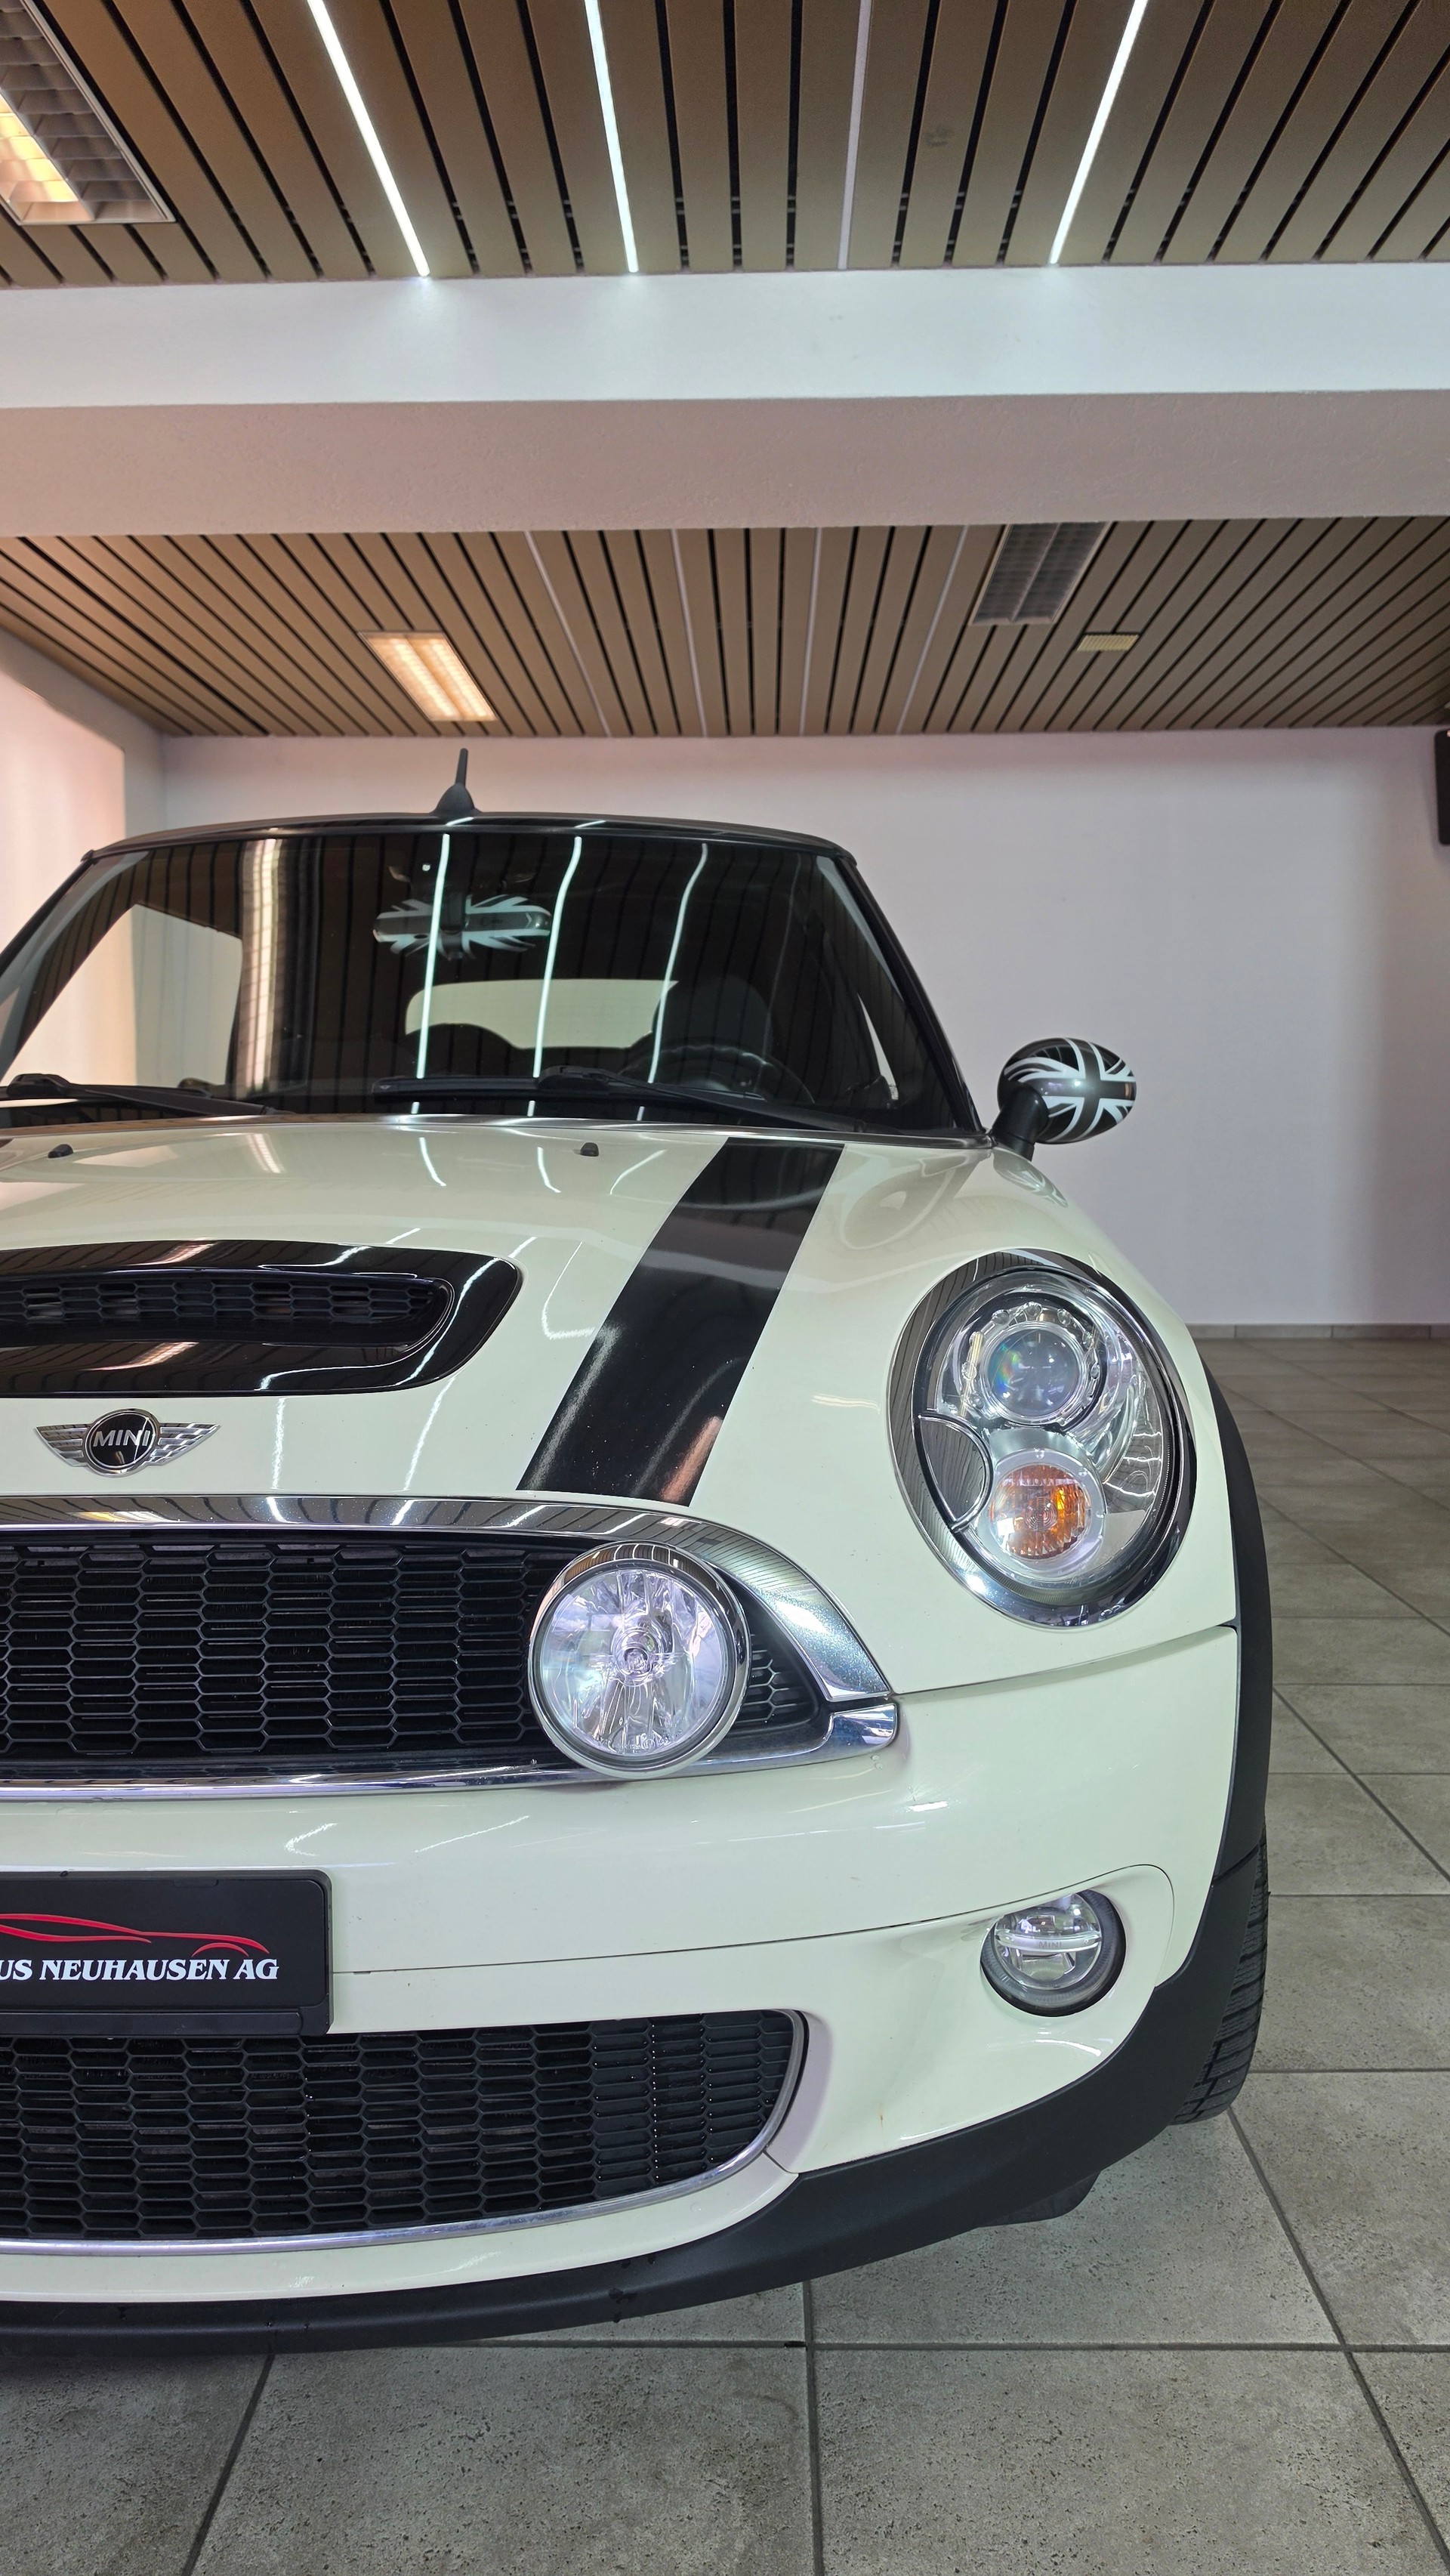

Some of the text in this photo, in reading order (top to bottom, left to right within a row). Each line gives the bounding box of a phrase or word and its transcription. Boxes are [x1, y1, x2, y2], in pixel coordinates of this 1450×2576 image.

[93, 1429, 150, 1447] MINI
[39, 1959, 230, 1981] NEUHAUSEN
[233, 1958, 279, 1980] AG
